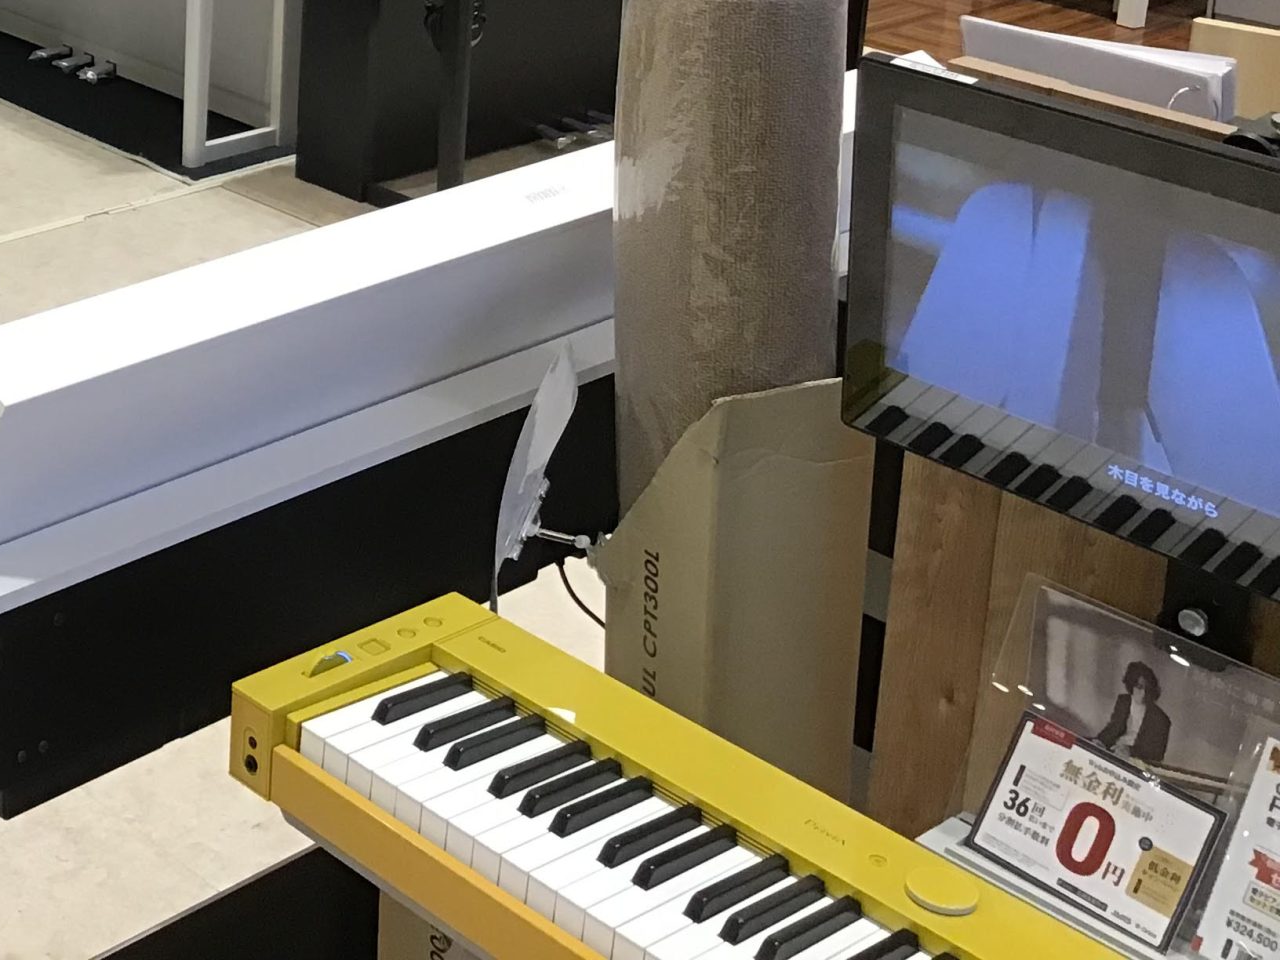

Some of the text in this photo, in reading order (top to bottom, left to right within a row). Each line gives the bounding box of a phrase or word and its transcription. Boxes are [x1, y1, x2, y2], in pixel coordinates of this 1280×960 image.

[1107, 464, 1219, 519] 木目を見ながら
[643, 549, 660, 658] CPT300L
[1003, 789, 1031, 818] 36
[1059, 759, 1124, 806] 無金利
[1055, 801, 1125, 887] 0 円
